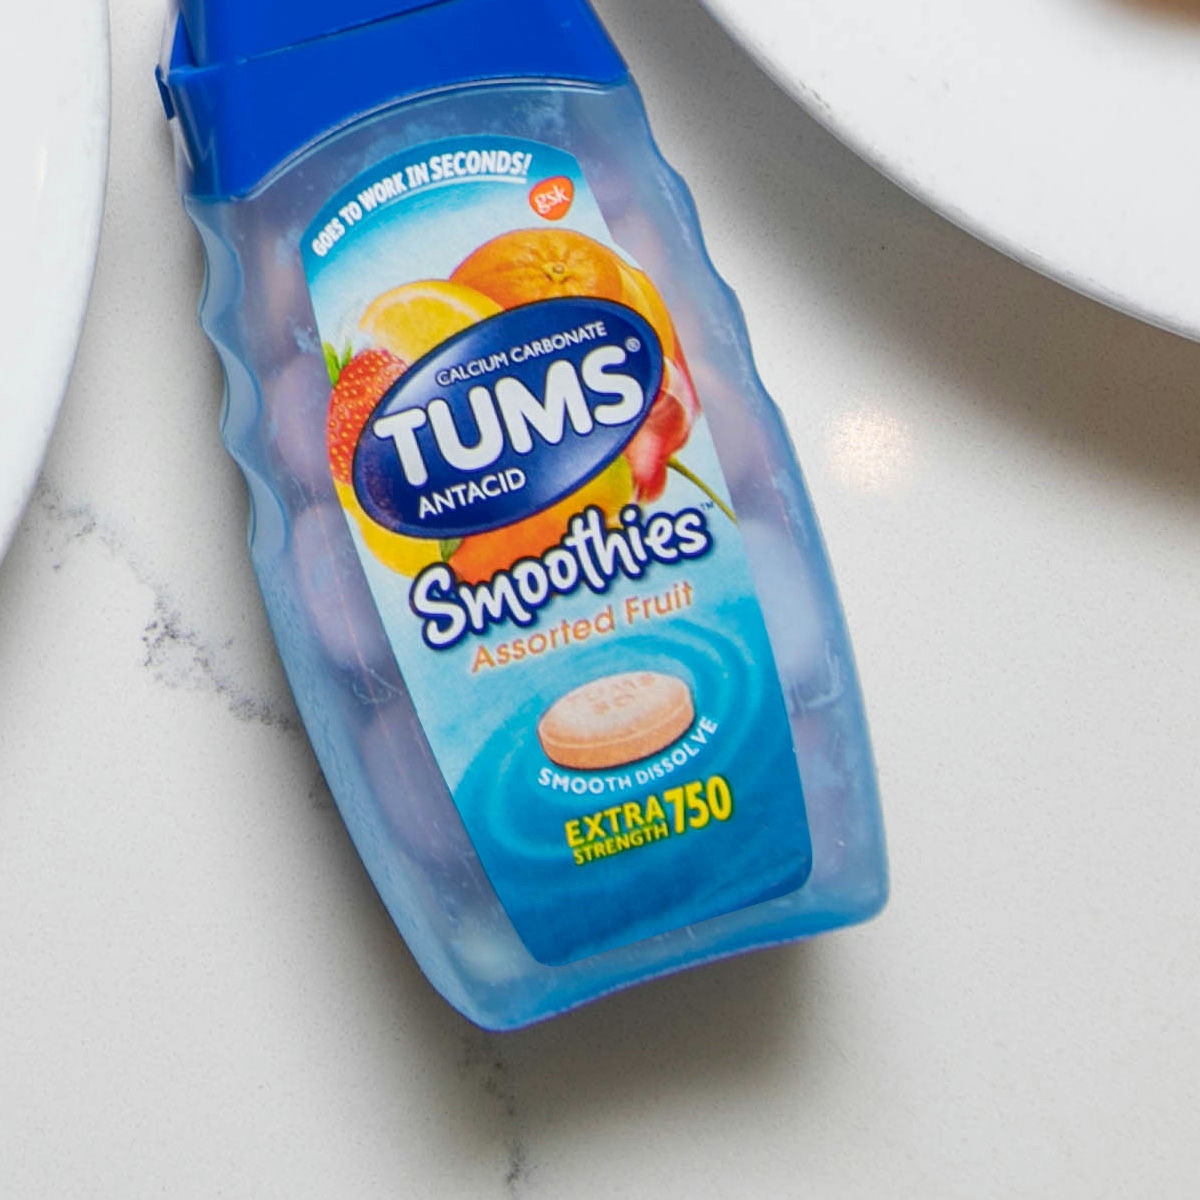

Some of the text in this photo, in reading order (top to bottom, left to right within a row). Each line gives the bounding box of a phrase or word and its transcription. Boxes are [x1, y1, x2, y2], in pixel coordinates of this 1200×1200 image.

[311, 150, 532, 257] GOES TO WORK IN SECONDS!
[533, 185, 570, 215] gsk
[436, 321, 607, 386] CALCIUM CARBONATE
[418, 467, 527, 519] ANTACID
[471, 581, 694, 674] Assorted Fruit
[538, 715, 718, 794] SMOOTH DISSOLVE
[565, 775, 732, 848] EXTRA 750
[573, 822, 669, 866] STRENGTH
